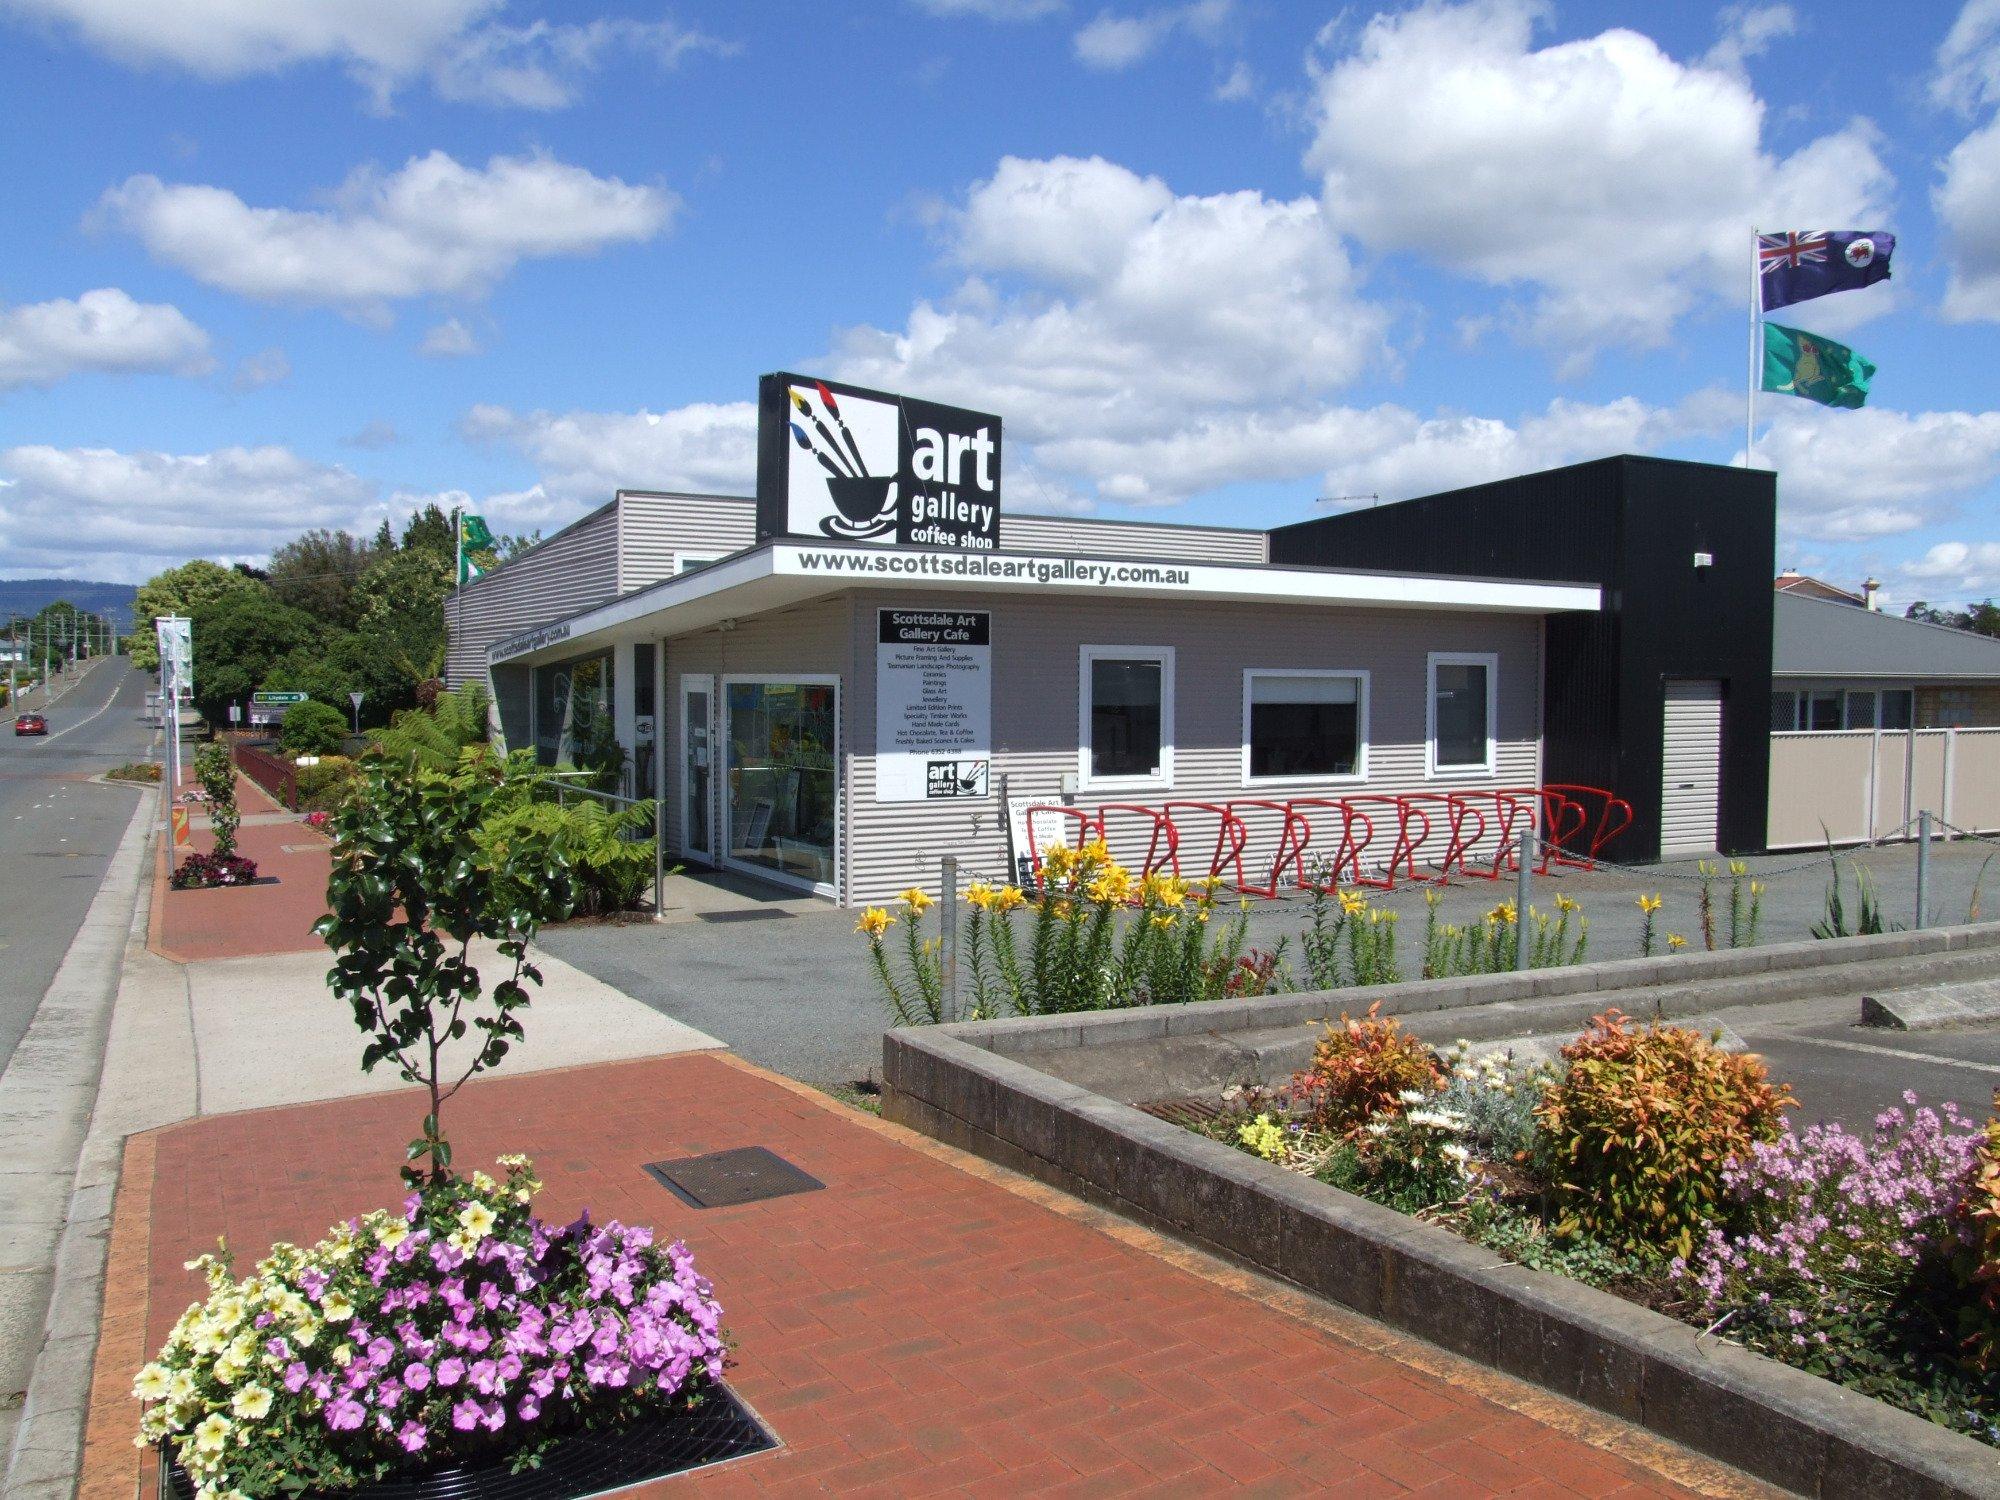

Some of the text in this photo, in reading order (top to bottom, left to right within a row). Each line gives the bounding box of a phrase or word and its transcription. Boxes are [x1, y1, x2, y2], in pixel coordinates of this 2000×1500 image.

[912, 427, 994, 491] art
[911, 491, 994, 532] gallery
[910, 525, 993, 549] coffee shop
[798, 552, 1190, 586] www.scottsdaleartgallery.com.au
[892, 613, 976, 627] Scottsdale Art
[899, 628, 970, 642] Gallery Cafe
[937, 646, 956, 654] Gallery
[916, 654, 938, 662] Framing
[946, 663, 980, 671] Photography
[895, 738, 915, 746] Freshly
[928, 763, 955, 780] art
[928, 780, 955, 790] gallery
